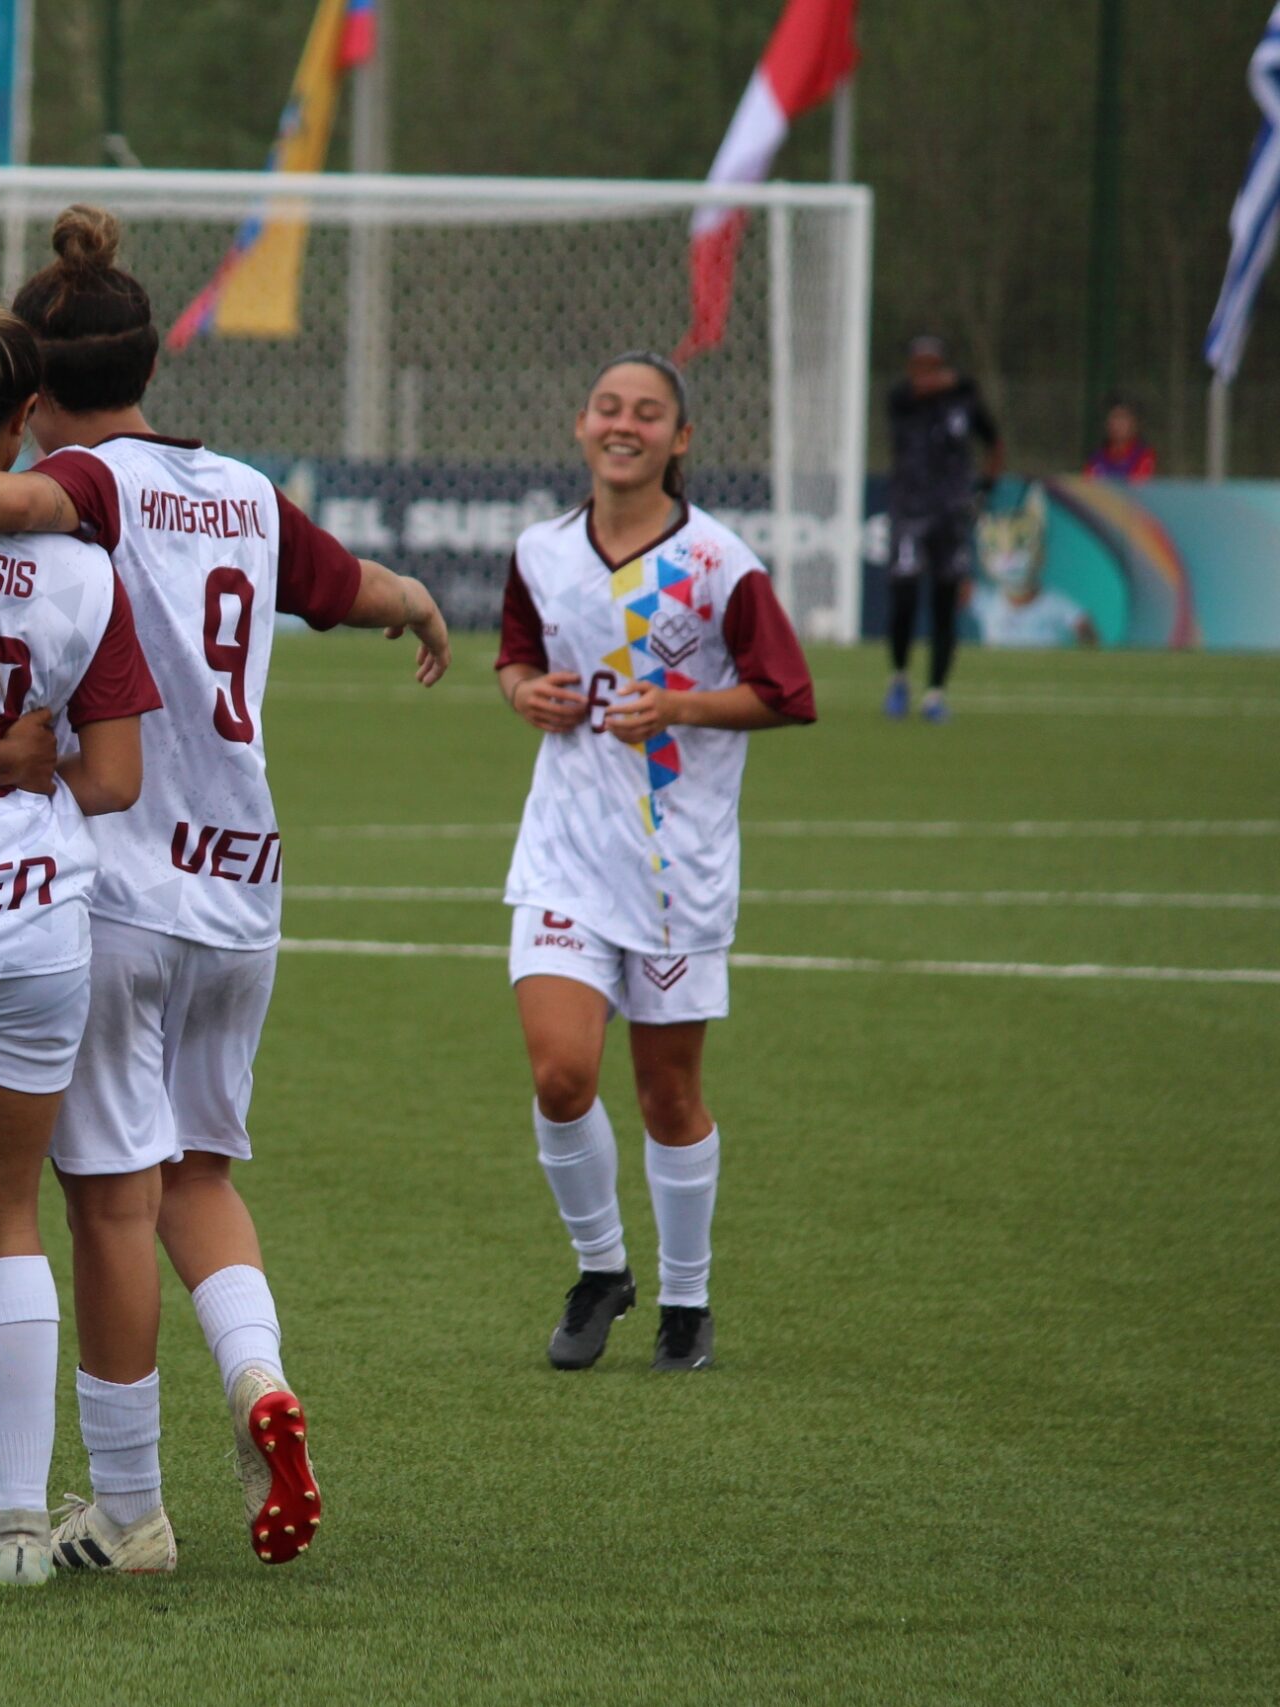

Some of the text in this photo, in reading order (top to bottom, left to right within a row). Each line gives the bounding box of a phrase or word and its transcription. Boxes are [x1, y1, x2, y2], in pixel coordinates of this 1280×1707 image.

[203, 566, 256, 745] 9
[587, 670, 618, 734] 6
[170, 821, 282, 884] VEN
[545, 933, 585, 951] ROLY
